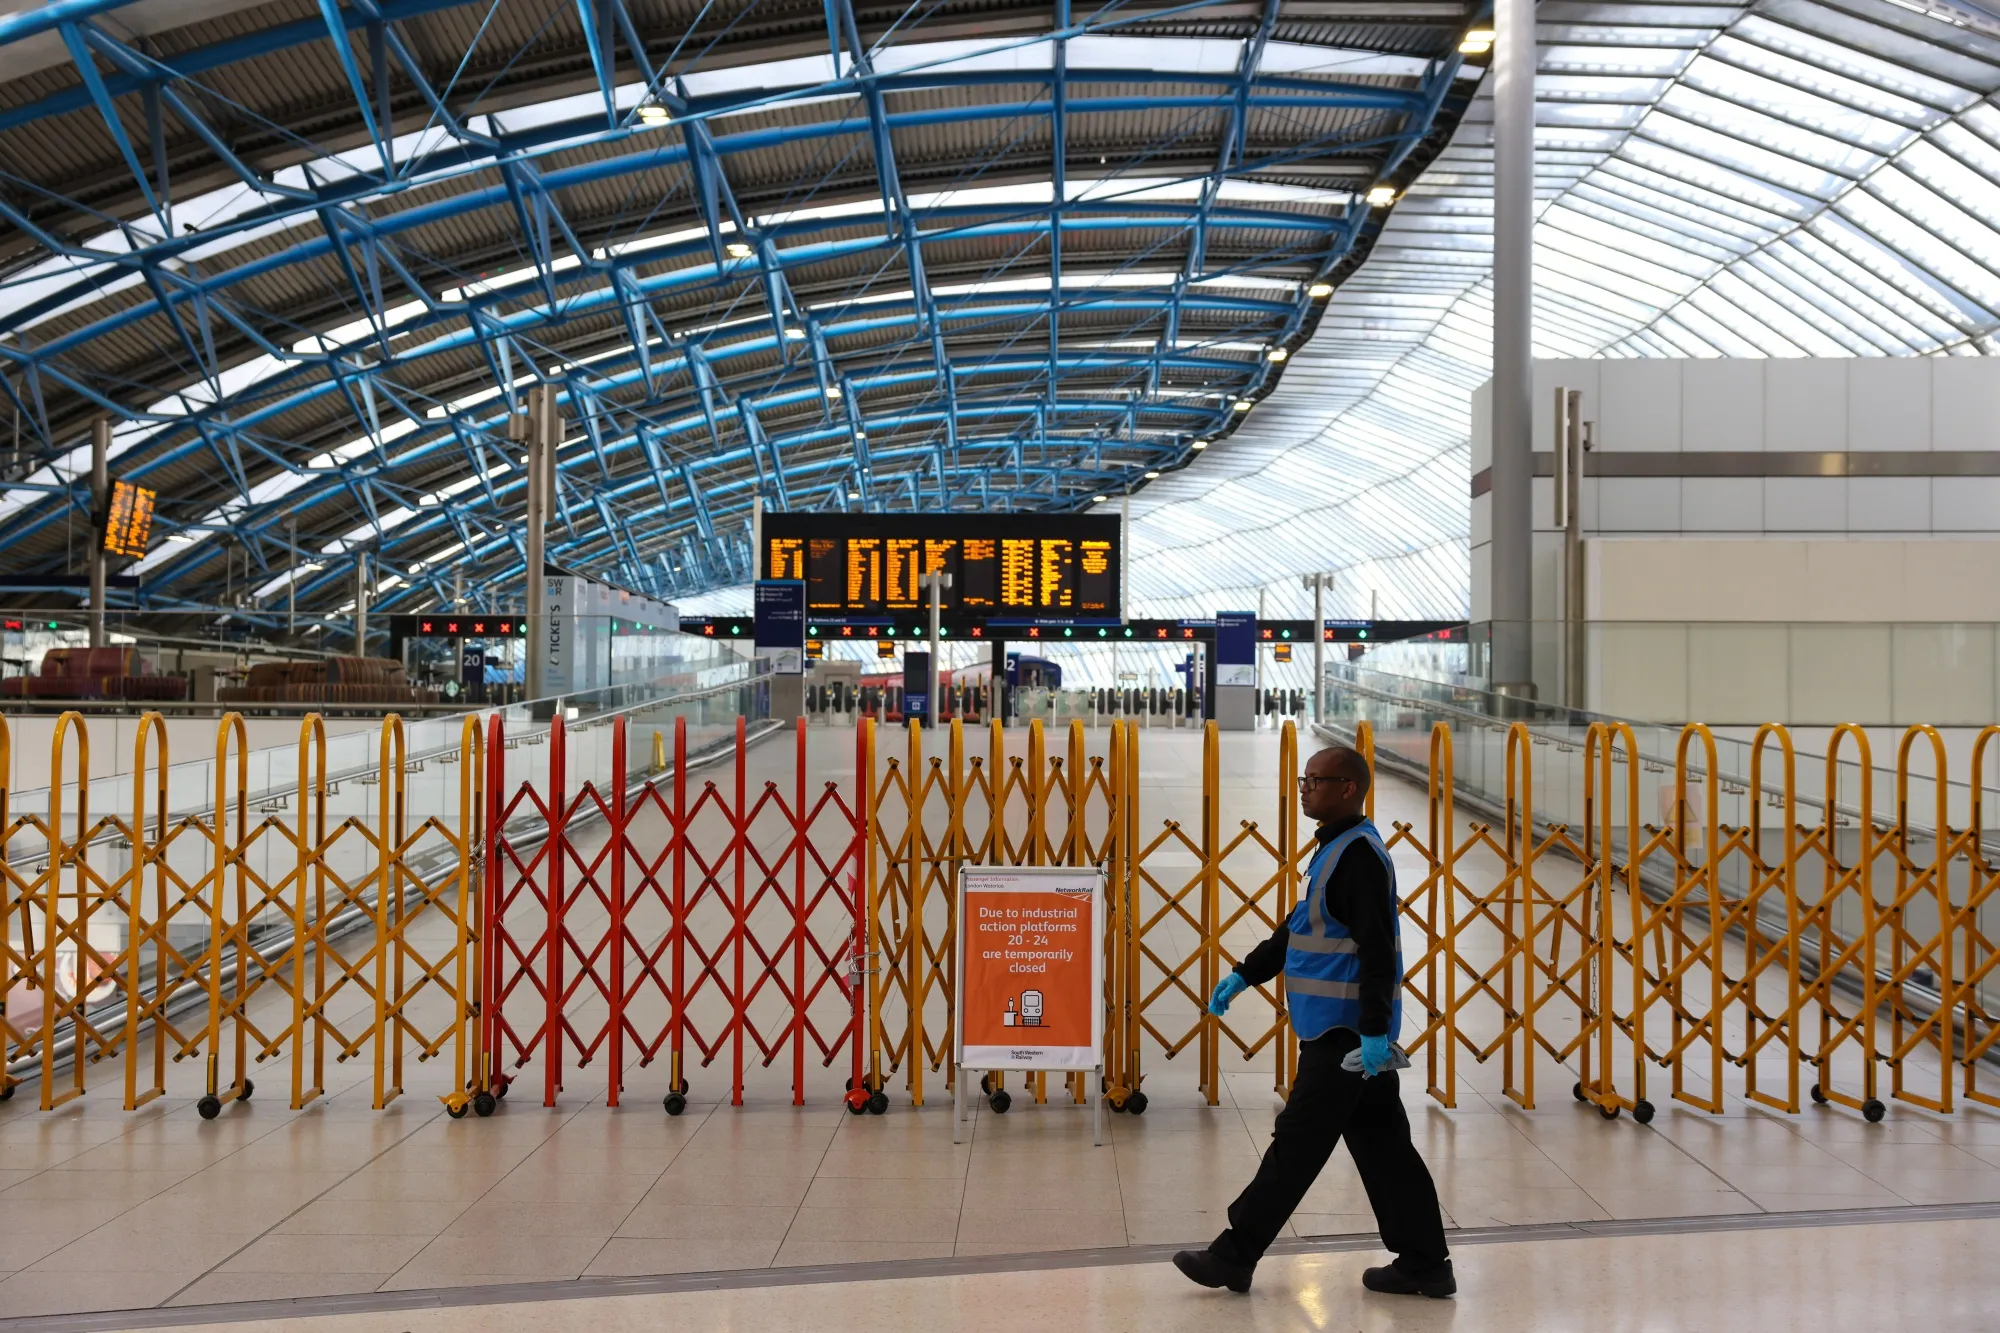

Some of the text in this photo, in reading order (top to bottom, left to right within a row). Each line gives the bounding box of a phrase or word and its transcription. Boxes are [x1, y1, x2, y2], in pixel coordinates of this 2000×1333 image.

[549, 604, 560, 654] TICKETS
[463, 654, 480, 667] 20
[979, 907, 1078, 918] Due to industrial
[979, 921, 1077, 935] action platforms
[1007, 935, 1023, 946] 20
[1033, 935, 1049, 946] 24
[982, 949, 1073, 962] are temporarily
[1009, 962, 1046, 973] closed
